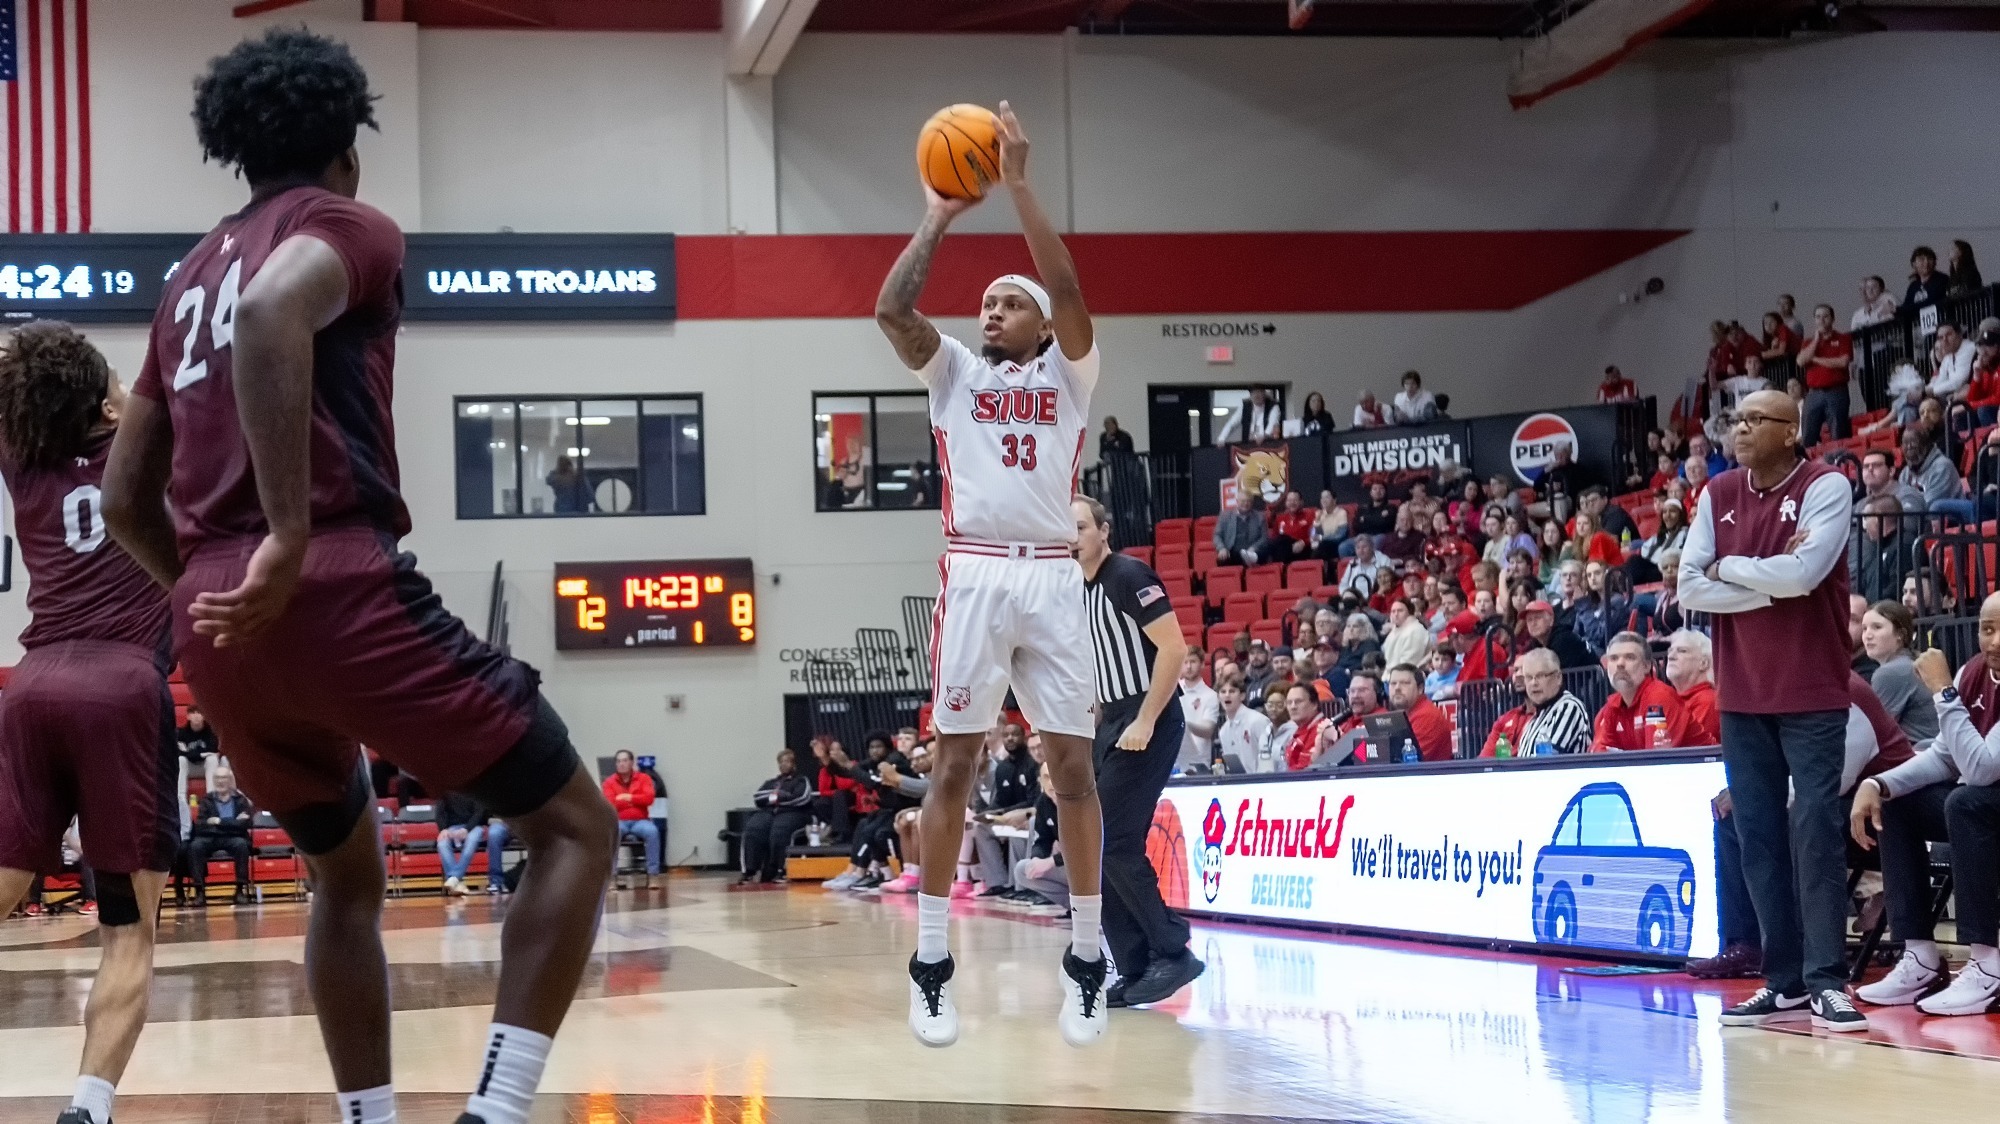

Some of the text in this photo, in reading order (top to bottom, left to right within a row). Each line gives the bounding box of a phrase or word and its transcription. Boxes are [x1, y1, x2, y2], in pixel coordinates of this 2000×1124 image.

[102, 271, 134, 293] 19
[428, 269, 657, 294] UALR TROJANS
[174, 256, 241, 391] 24
[1162, 322, 1259, 337] RESTROOMS
[970, 387, 1058, 425] SIUE
[1002, 434, 1037, 471] 33
[1335, 443, 1460, 476] DIVISION I
[1343, 433, 1450, 455] THE METRO EAST'S
[62, 485, 107, 553] 0
[625, 575, 700, 608] 14:23
[578, 593, 753, 630] 12 8
[637, 620, 703, 644] period 1
[1352, 834, 1523, 898] We'll travel to you!
[1251, 873, 1313, 909] DELIVERS
